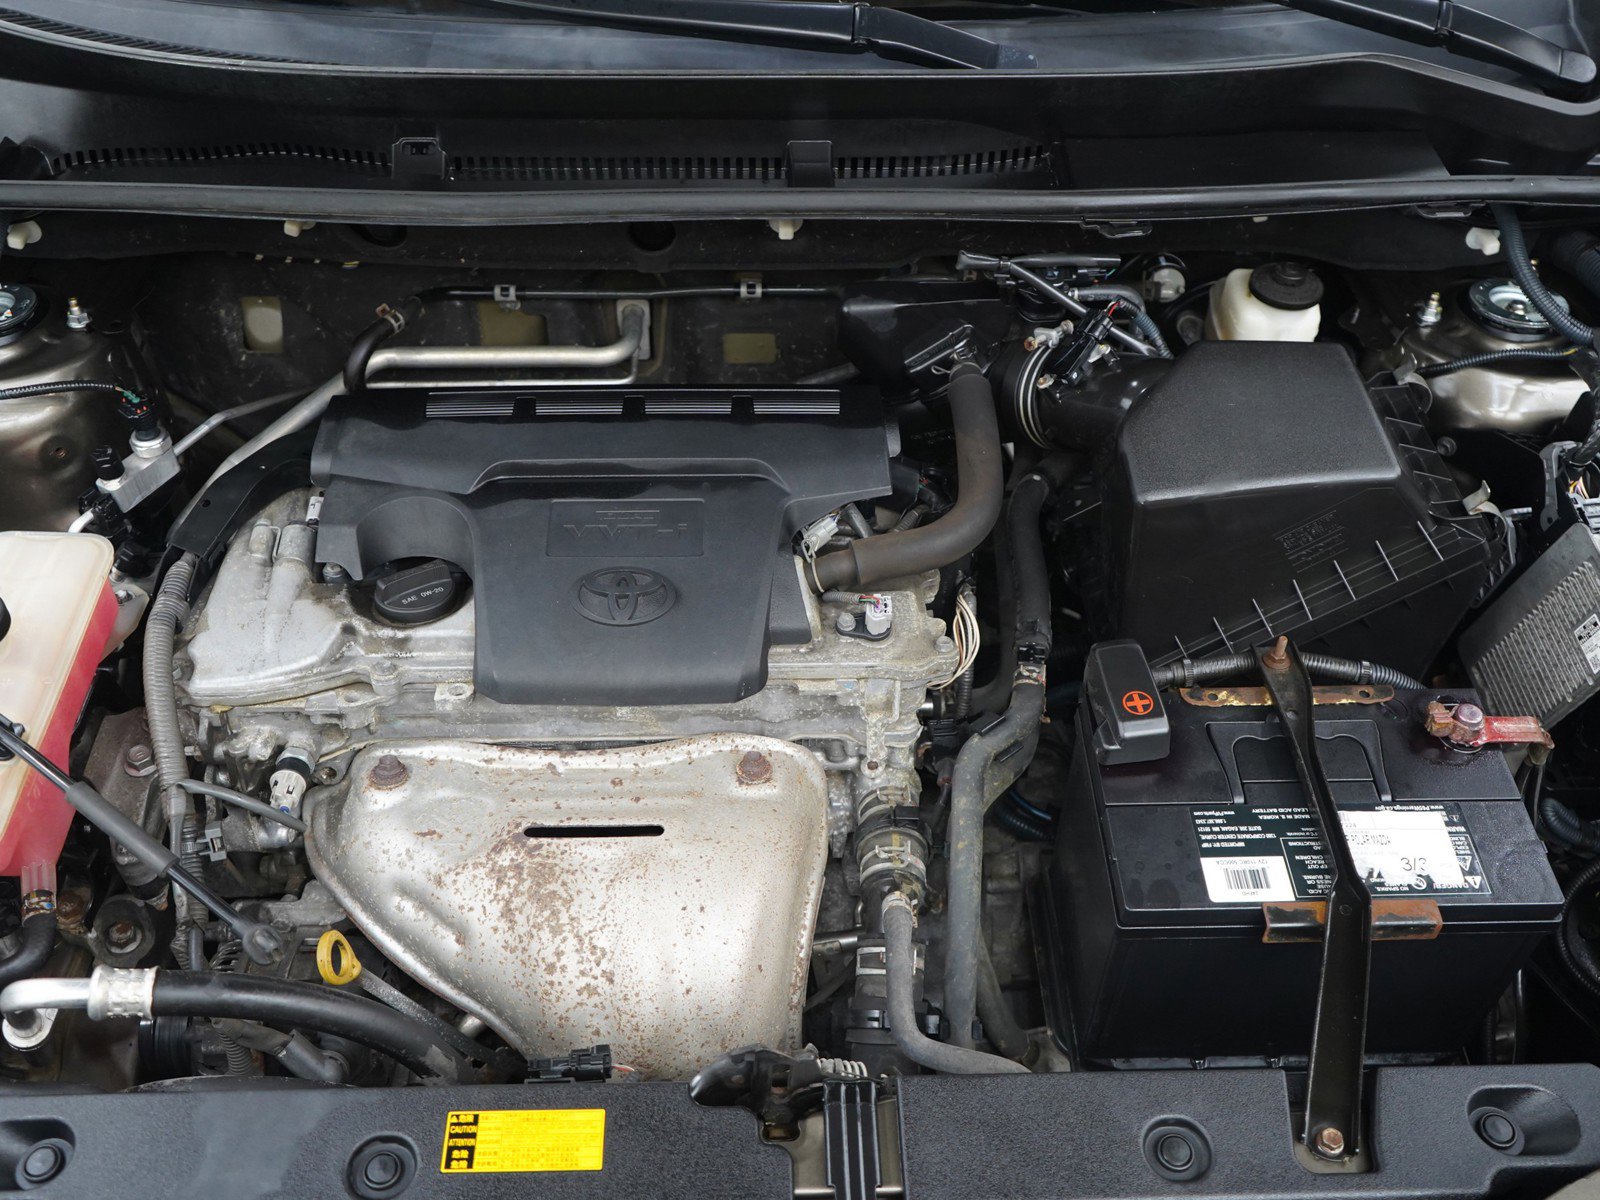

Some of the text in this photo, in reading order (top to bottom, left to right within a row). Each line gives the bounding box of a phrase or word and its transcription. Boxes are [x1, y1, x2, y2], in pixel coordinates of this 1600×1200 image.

[402, 587, 444, 604] SAE 0W-20
[450, 1125, 477, 1133] CAUTION
[449, 1138, 475, 1146] ATTENTION
